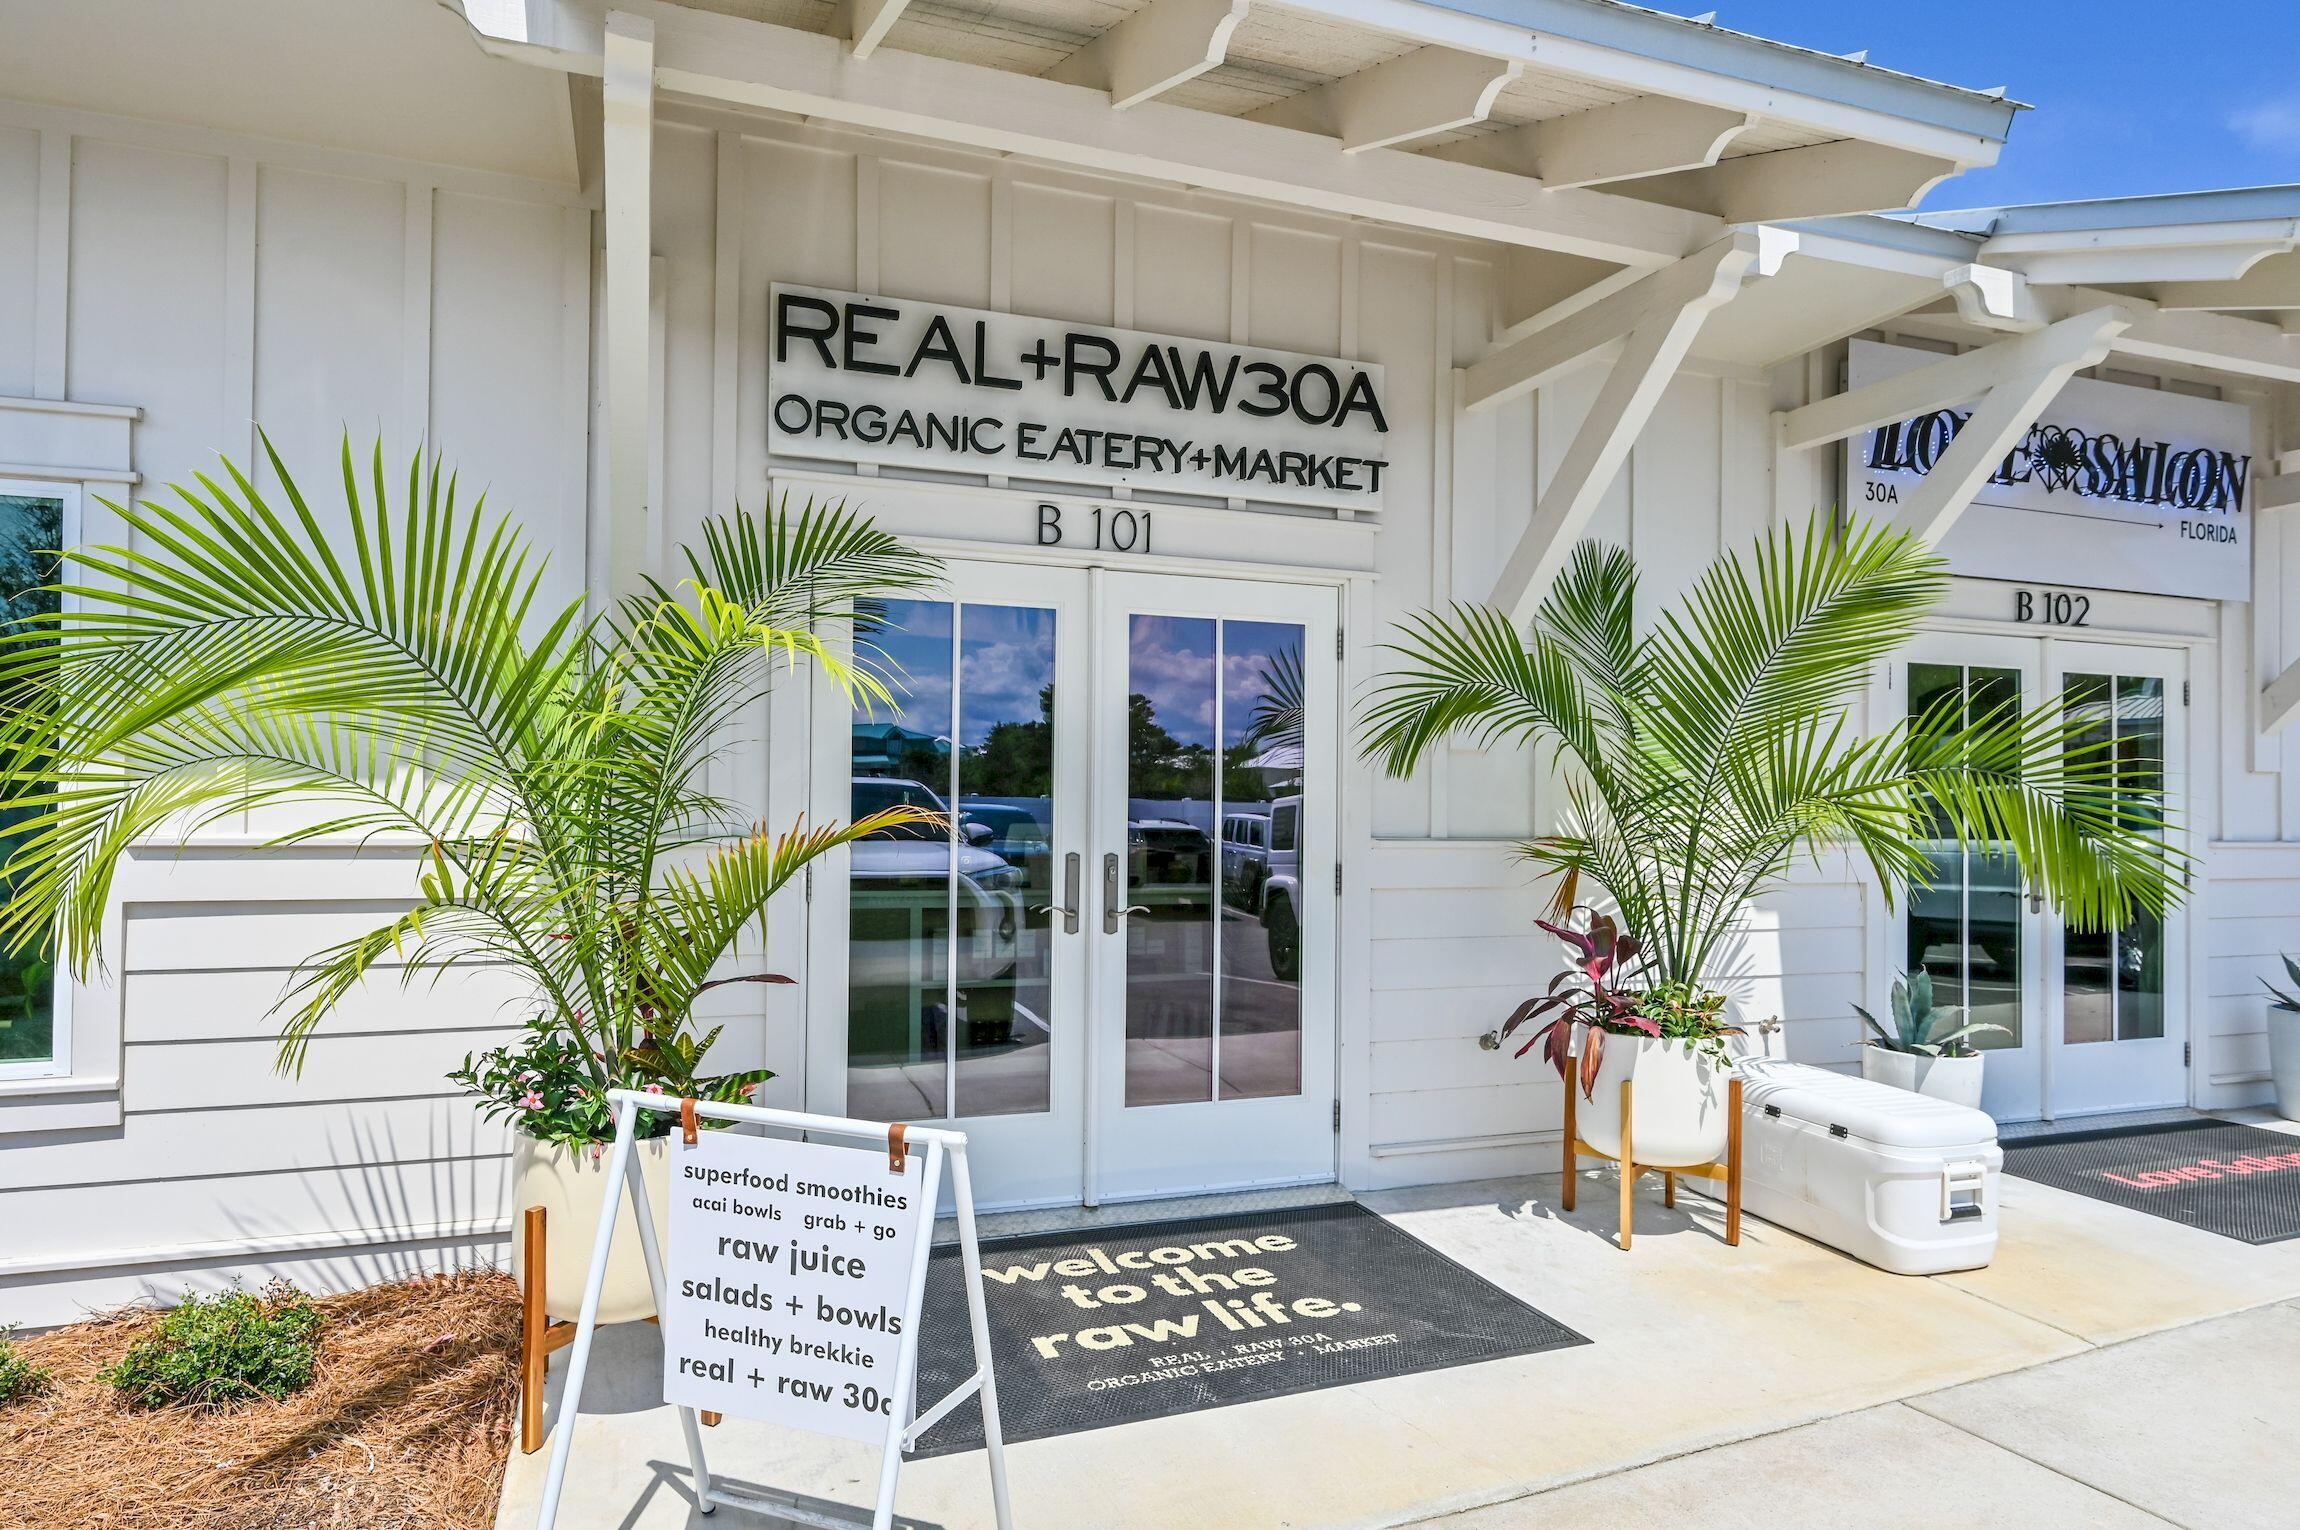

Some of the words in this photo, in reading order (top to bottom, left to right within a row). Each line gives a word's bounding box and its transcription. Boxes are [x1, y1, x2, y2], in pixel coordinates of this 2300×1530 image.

[773, 393, 1006, 455] ORGANIC
[1016, 421, 1389, 494] EATERY+MARKET
[1865, 481, 1899, 504] 30A
[2086, 432, 2252, 514] SALON
[1038, 504, 1062, 546] B
[1092, 507, 1153, 553] 101
[2180, 521, 2237, 544] FLORIDA
[2016, 591, 2033, 622] B
[2043, 593, 2090, 627] 102
[683, 1164, 789, 1193] superfood
[796, 1180, 908, 1210] smoothies
[692, 1196, 727, 1213] acai
[733, 1199, 782, 1221] bowls
[804, 1213, 847, 1231] grab
[873, 1224, 896, 1241] go
[718, 1236, 779, 1264] raw
[789, 1240, 866, 1279] juice
[982, 1234, 1298, 1285] welcome
[681, 1277, 773, 1311] salads
[817, 1295, 902, 1335] bowls
[1061, 1283, 1148, 1309] to
[1151, 1265, 1278, 1297] the
[705, 1319, 783, 1355] healthy
[790, 1334, 875, 1369] brekkie
[1031, 1314, 1200, 1360] raw
[1201, 1291, 1362, 1331] life.
[1086, 1364, 1199, 1391] ORGANIC
[1199, 1350, 1286, 1373] EATERY
[1311, 1333, 1400, 1355] MARKET
[1148, 1349, 1212, 1368] REAL
[1231, 1338, 1284, 1355] RAW
[1288, 1332, 1333, 1346] 30A
[679, 1356, 735, 1383] real
[778, 1375, 834, 1403] raw
